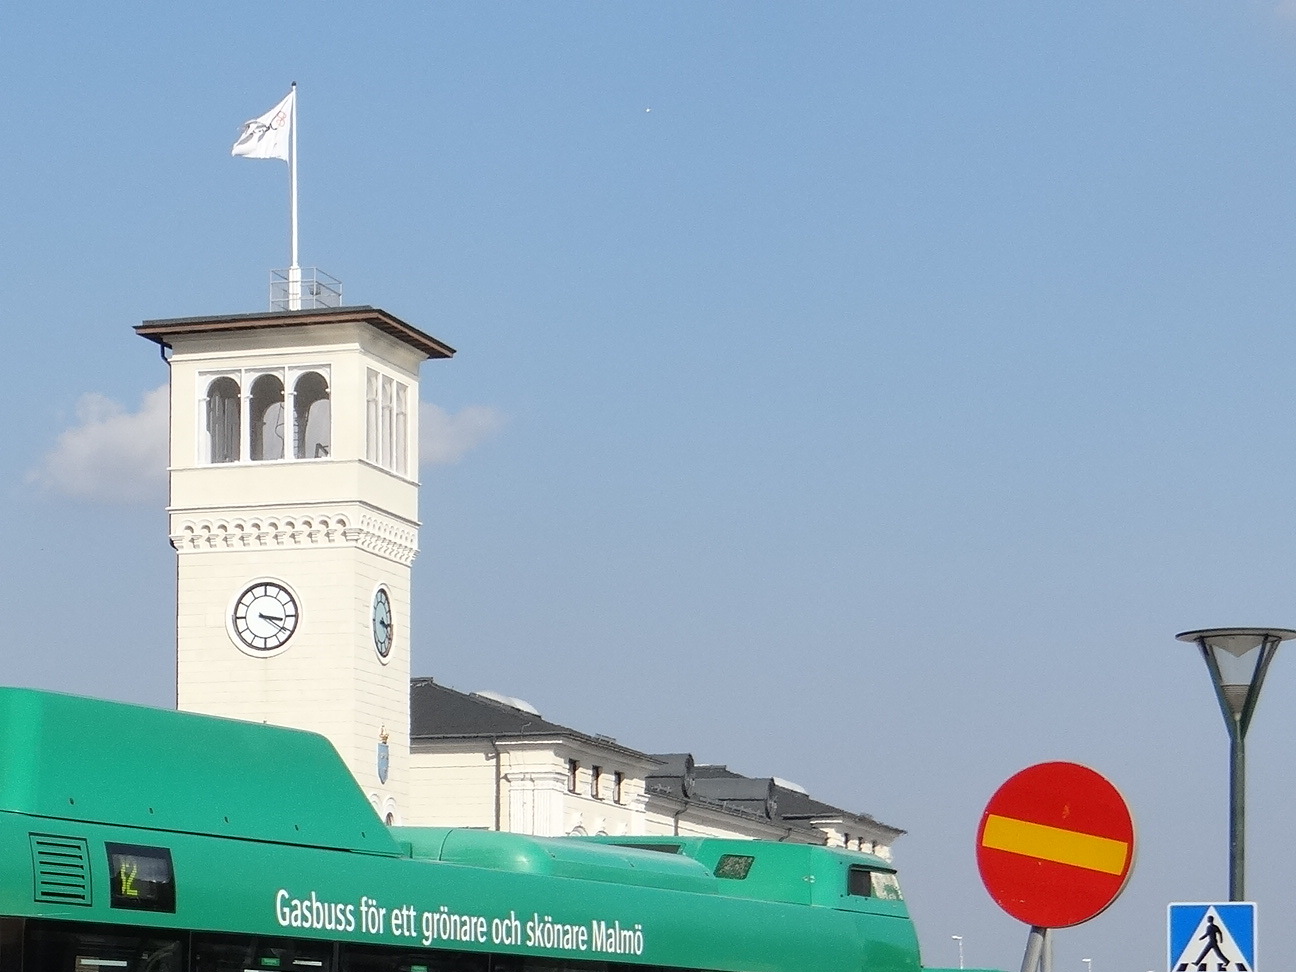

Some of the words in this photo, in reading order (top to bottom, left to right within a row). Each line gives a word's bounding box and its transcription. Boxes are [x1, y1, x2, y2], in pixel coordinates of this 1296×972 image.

[276, 889, 355, 932] Gasbuss
[360, 896, 386, 934] för
[391, 904, 417, 937] ett
[422, 906, 487, 946] grönare
[492, 910, 521, 945] och
[526, 912, 588, 951] skönare
[592, 920, 644, 955] Malmö
